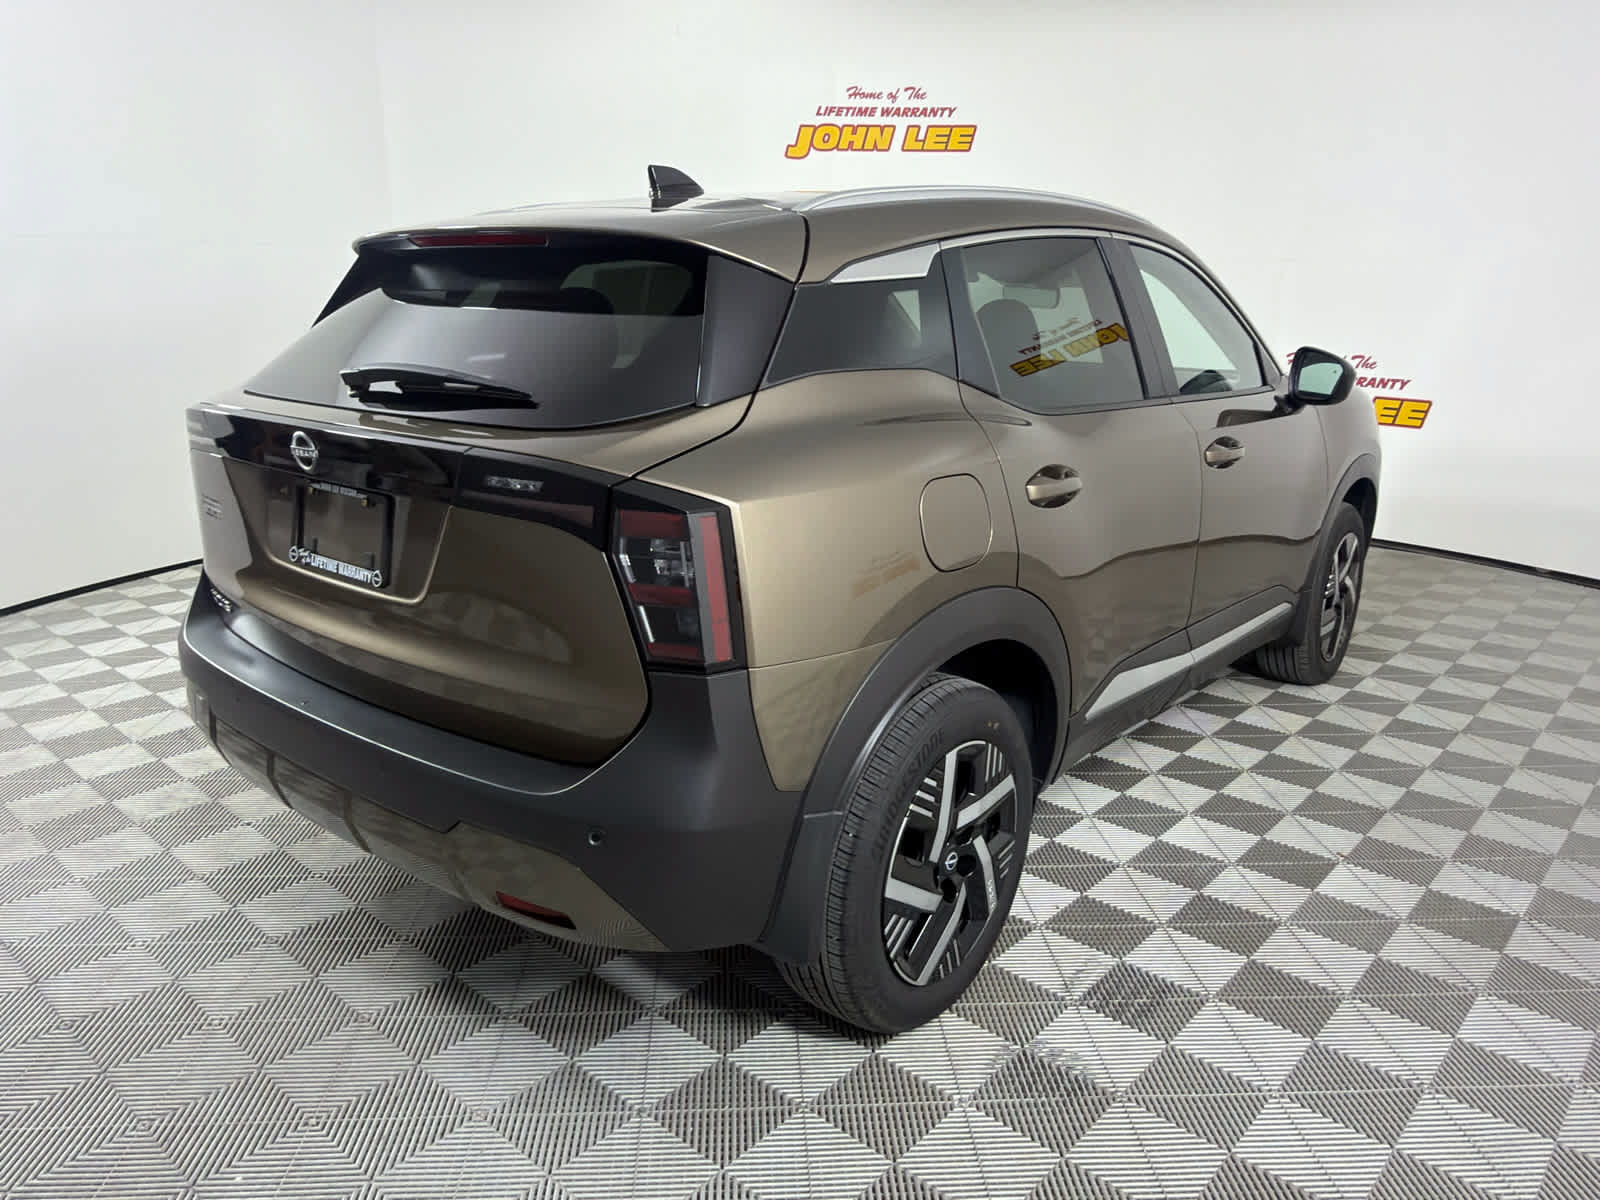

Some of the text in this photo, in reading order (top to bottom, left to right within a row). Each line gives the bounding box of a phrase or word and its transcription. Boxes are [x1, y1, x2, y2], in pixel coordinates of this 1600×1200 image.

[846, 85, 927, 104] Home of The
[815, 105, 958, 118] LIFETIME WARRANTY
[784, 123, 978, 160] JOHN LEE
[1351, 354, 1377, 370] The
[1355, 376, 1412, 390] RANTY
[1373, 396, 1433, 429] EE
